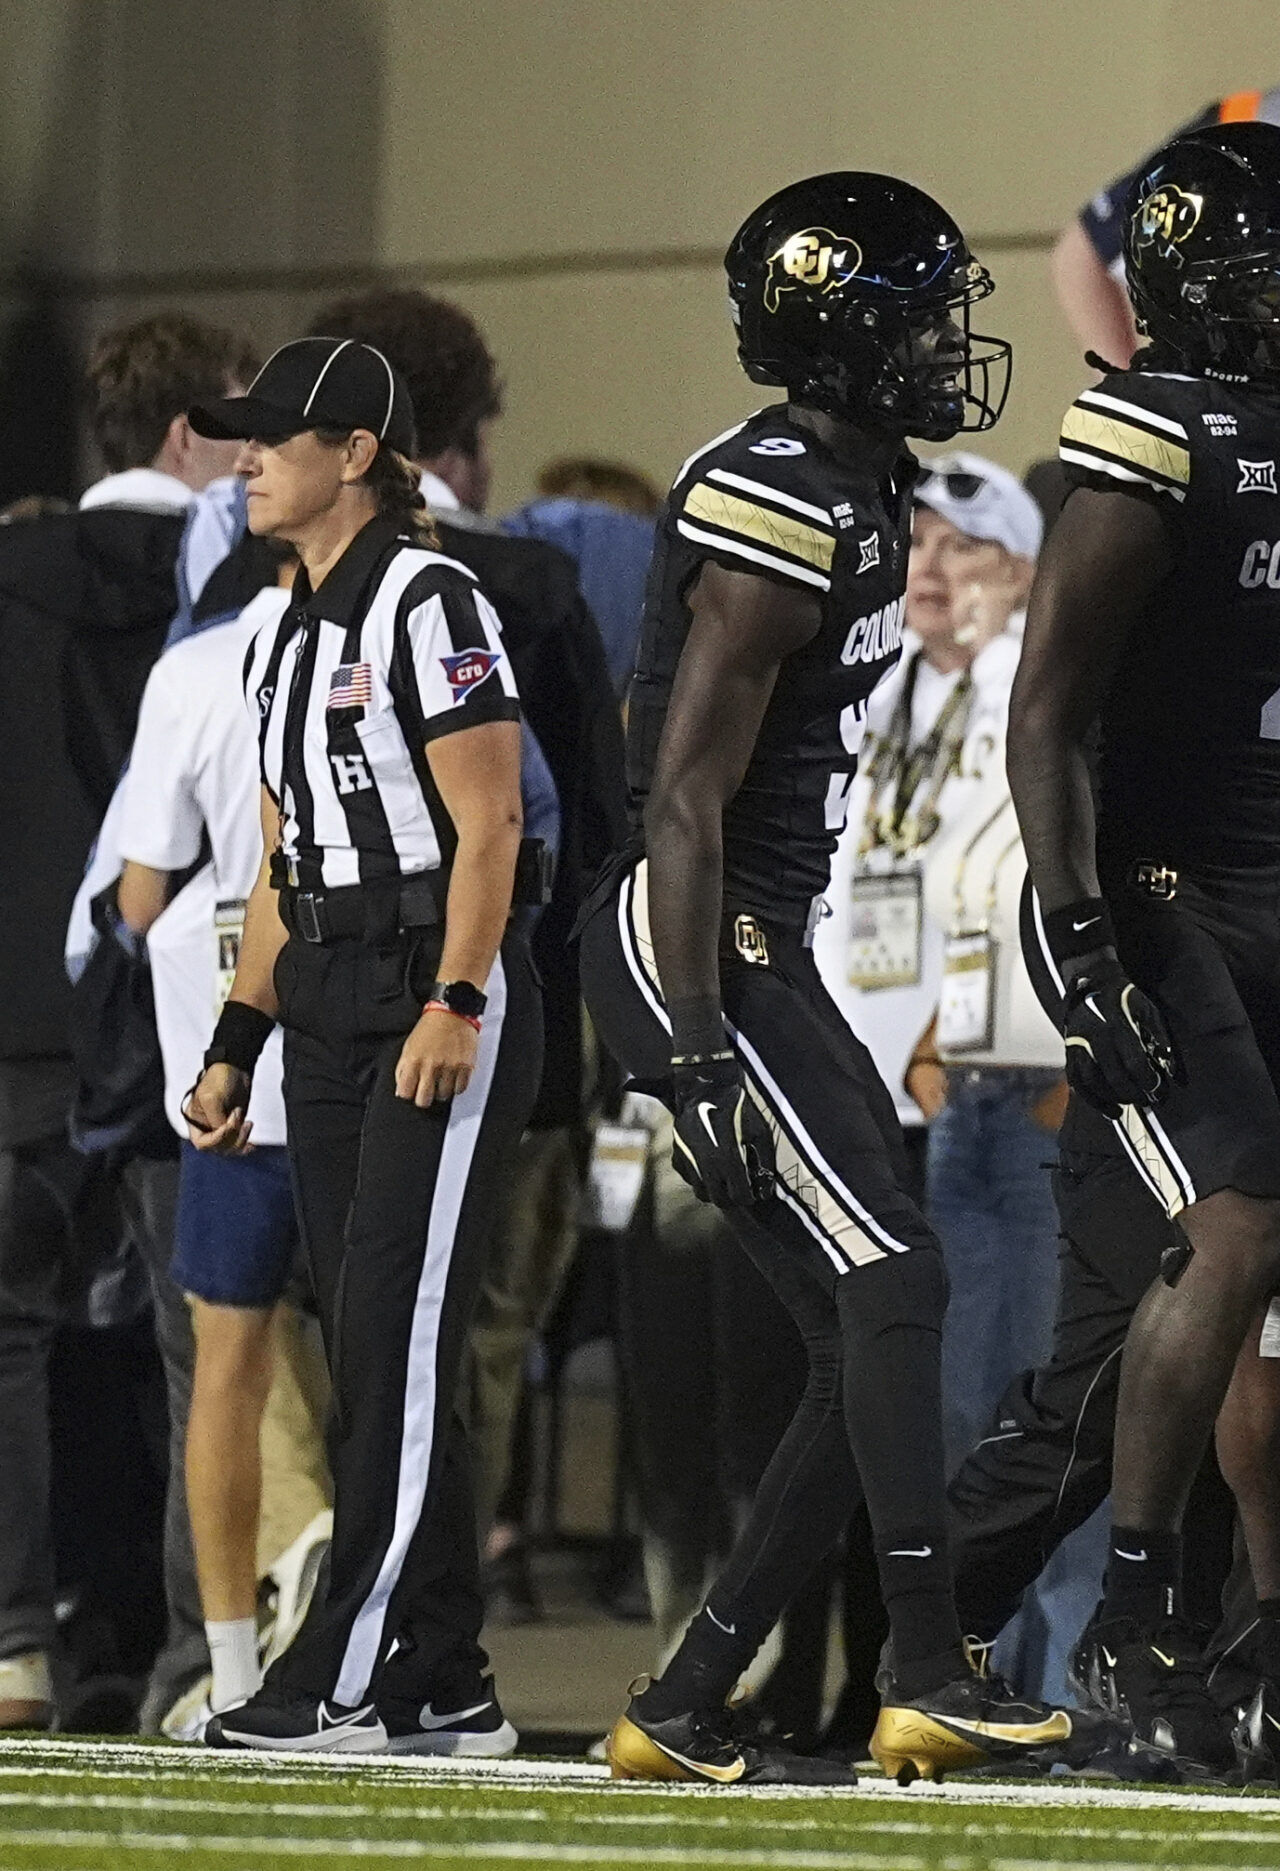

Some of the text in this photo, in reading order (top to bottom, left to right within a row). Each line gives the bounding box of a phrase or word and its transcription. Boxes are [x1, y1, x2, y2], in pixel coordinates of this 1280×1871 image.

[1202, 413, 1238, 425] mac
[1210, 426, 1237, 436] 82-94
[1240, 461, 1275, 491] XII
[331, 754, 373, 795] H
